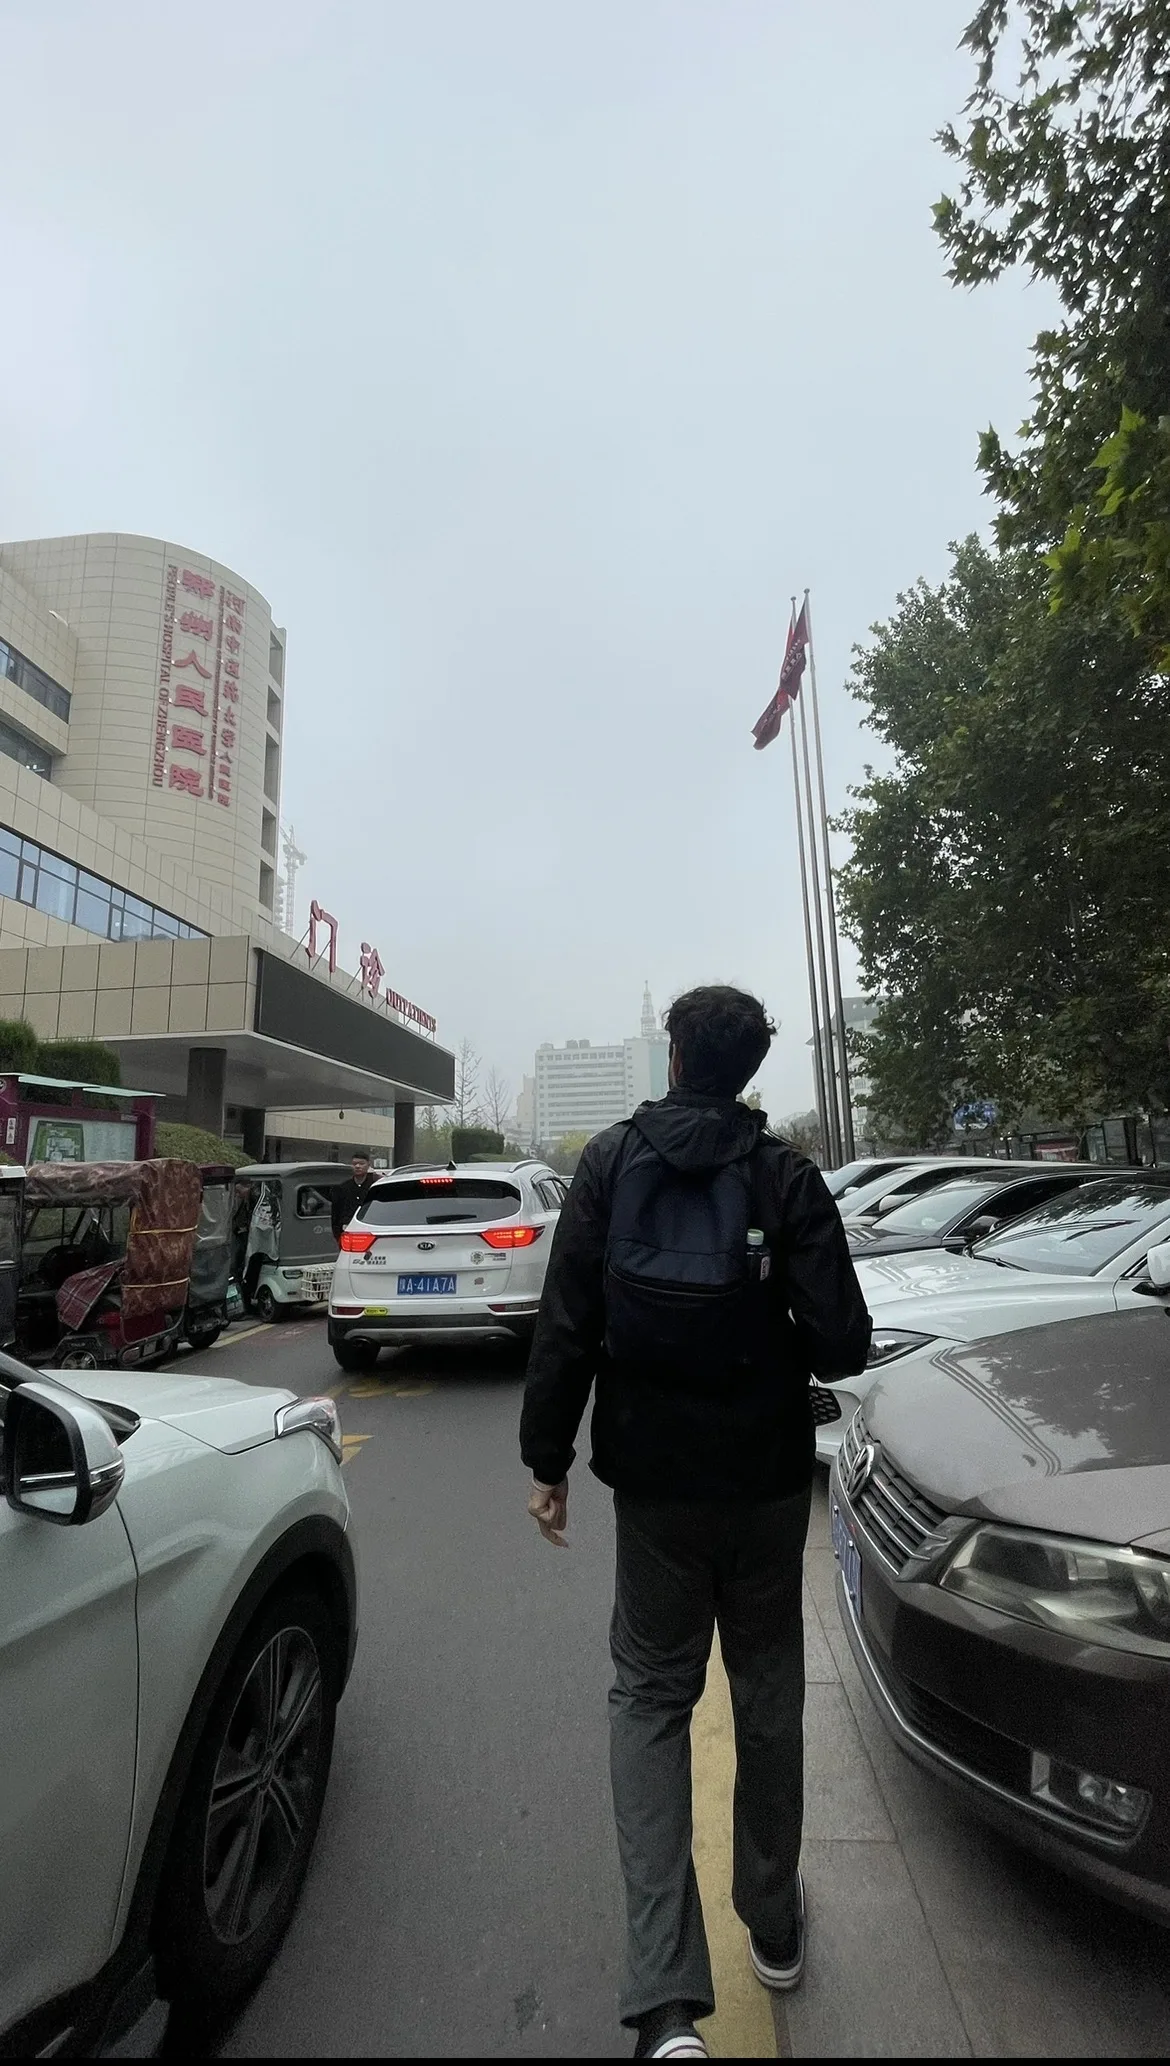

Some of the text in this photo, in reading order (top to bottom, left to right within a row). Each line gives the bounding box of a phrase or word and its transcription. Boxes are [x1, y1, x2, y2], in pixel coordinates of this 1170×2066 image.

[160, 624, 173, 684] HOSPITAL
[168, 568, 216, 797] 郑州人民医院
[153, 707, 168, 787] ZHENGZHOU
[305, 899, 385, 998] 门诊
